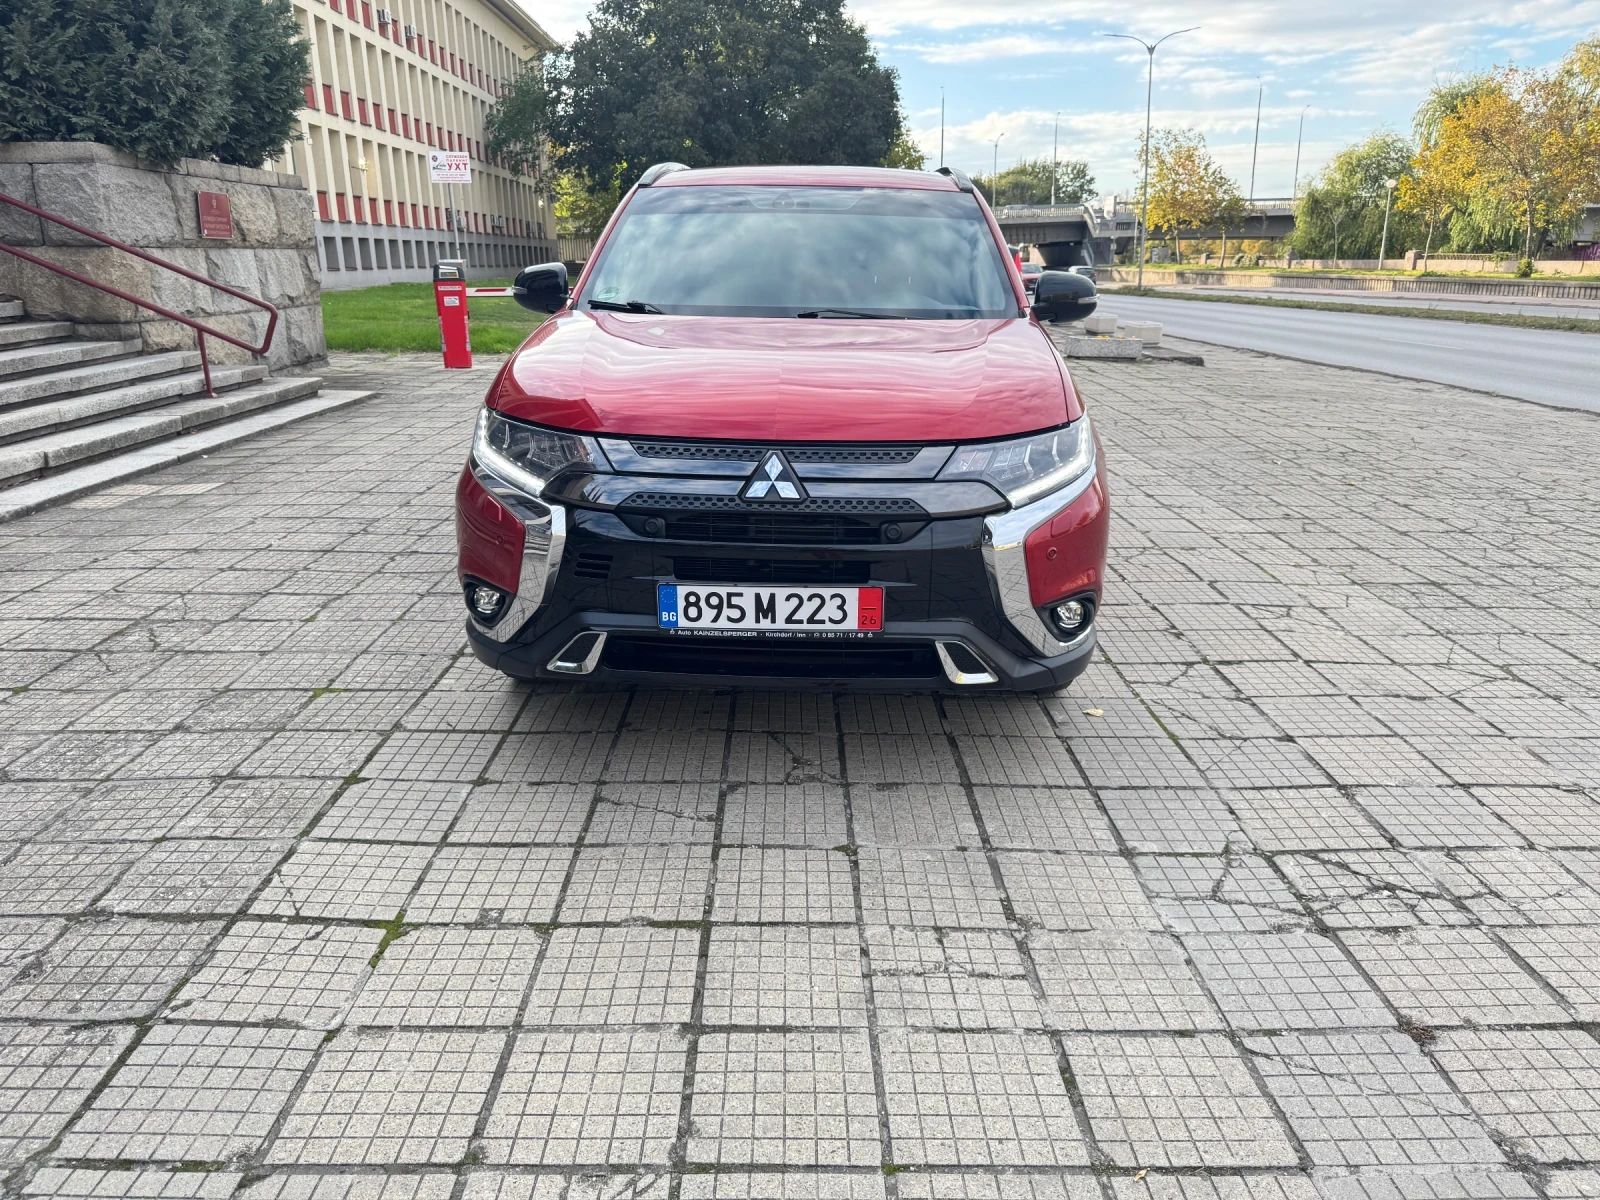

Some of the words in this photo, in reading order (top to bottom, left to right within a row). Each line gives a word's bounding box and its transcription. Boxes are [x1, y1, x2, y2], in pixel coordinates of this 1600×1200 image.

[683, 591, 746, 624] 895
[754, 592, 776, 624] M
[784, 593, 848, 625] 223
[662, 612, 676, 622] BG
[861, 615, 876, 625] 26
